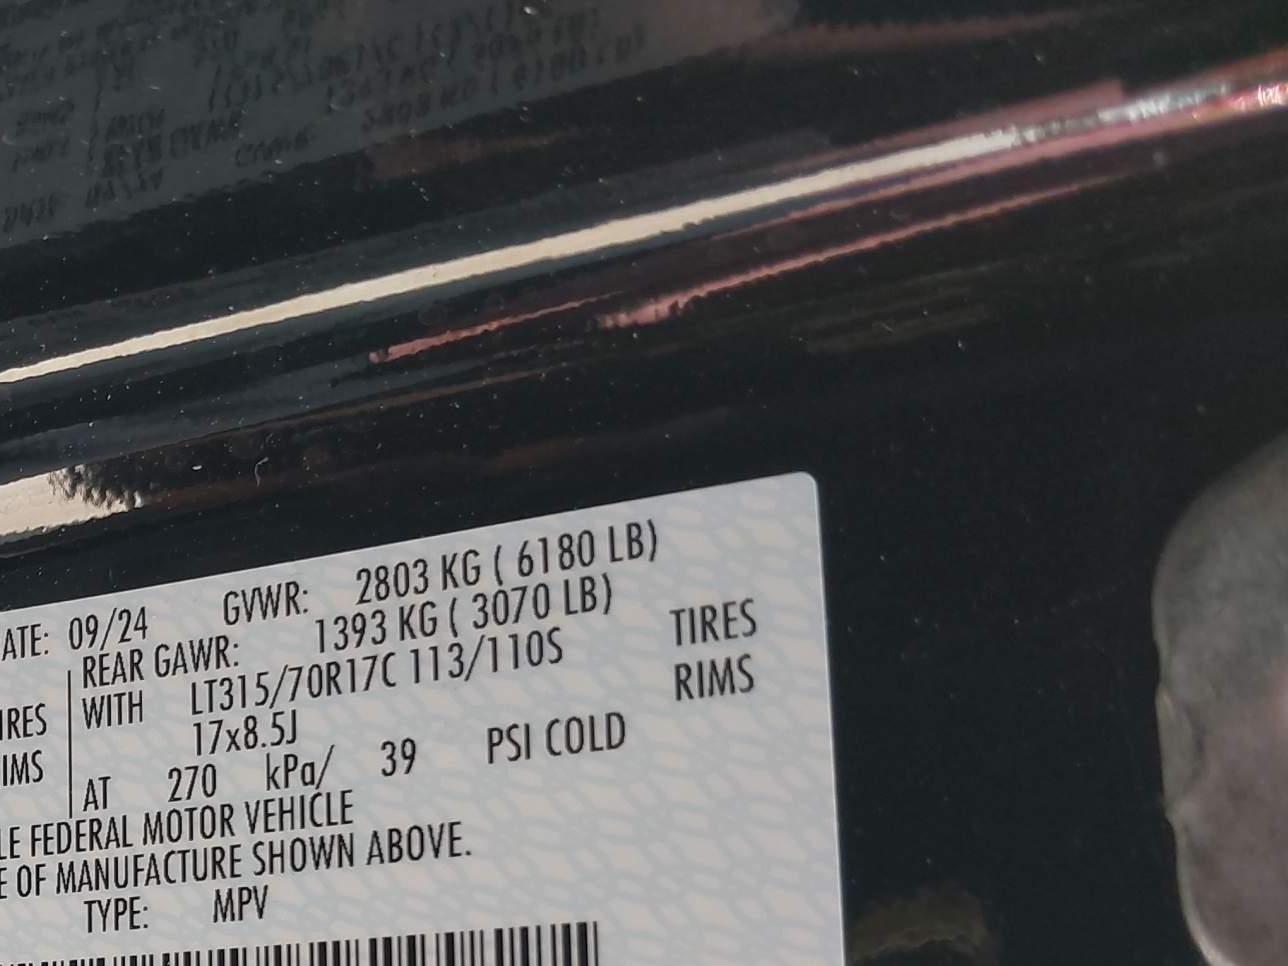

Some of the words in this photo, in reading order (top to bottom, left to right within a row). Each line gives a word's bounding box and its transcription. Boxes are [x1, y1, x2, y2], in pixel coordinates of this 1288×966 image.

[68, 605, 149, 652] 09/24
[223, 580, 309, 626] GVWR:
[355, 557, 429, 606] 2803
[441, 548, 481, 591] KG
[517, 529, 596, 578] 6180
[607, 518, 658, 563] LB)
[82, 648, 145, 689] REAR
[154, 634, 239, 678] GAWR:
[314, 611, 390, 654] 1393
[398, 600, 438, 642] KG
[471, 582, 551, 630] 3070
[563, 571, 613, 616] LB)
[81, 689, 144, 730] WITH
[191, 651, 397, 716] LT315/70R17C
[409, 627, 564, 683] 113/110S
[669, 597, 757, 647] TIRES
[192, 708, 297, 757] 17x8.5J
[674, 653, 755, 702] RIMS
[82, 775, 112, 813] AT
[167, 763, 217, 803] 270
[265, 744, 336, 792] kPa/
[380, 737, 417, 777] 39
[487, 722, 532, 765] PSI
[545, 711, 626, 757] COLD
[16, 863, 47, 898] OF
[55, 845, 244, 895] MANUFACTURE
[252, 831, 355, 877] SHOWN
[365, 820, 472, 866] ABOVE.
[30, 814, 134, 858] FEDERAL
[142, 803, 236, 847] MOTOR
[243, 788, 354, 835] VEHICLE
[83, 895, 149, 934] TYPE:
[212, 884, 269, 924] MPV
